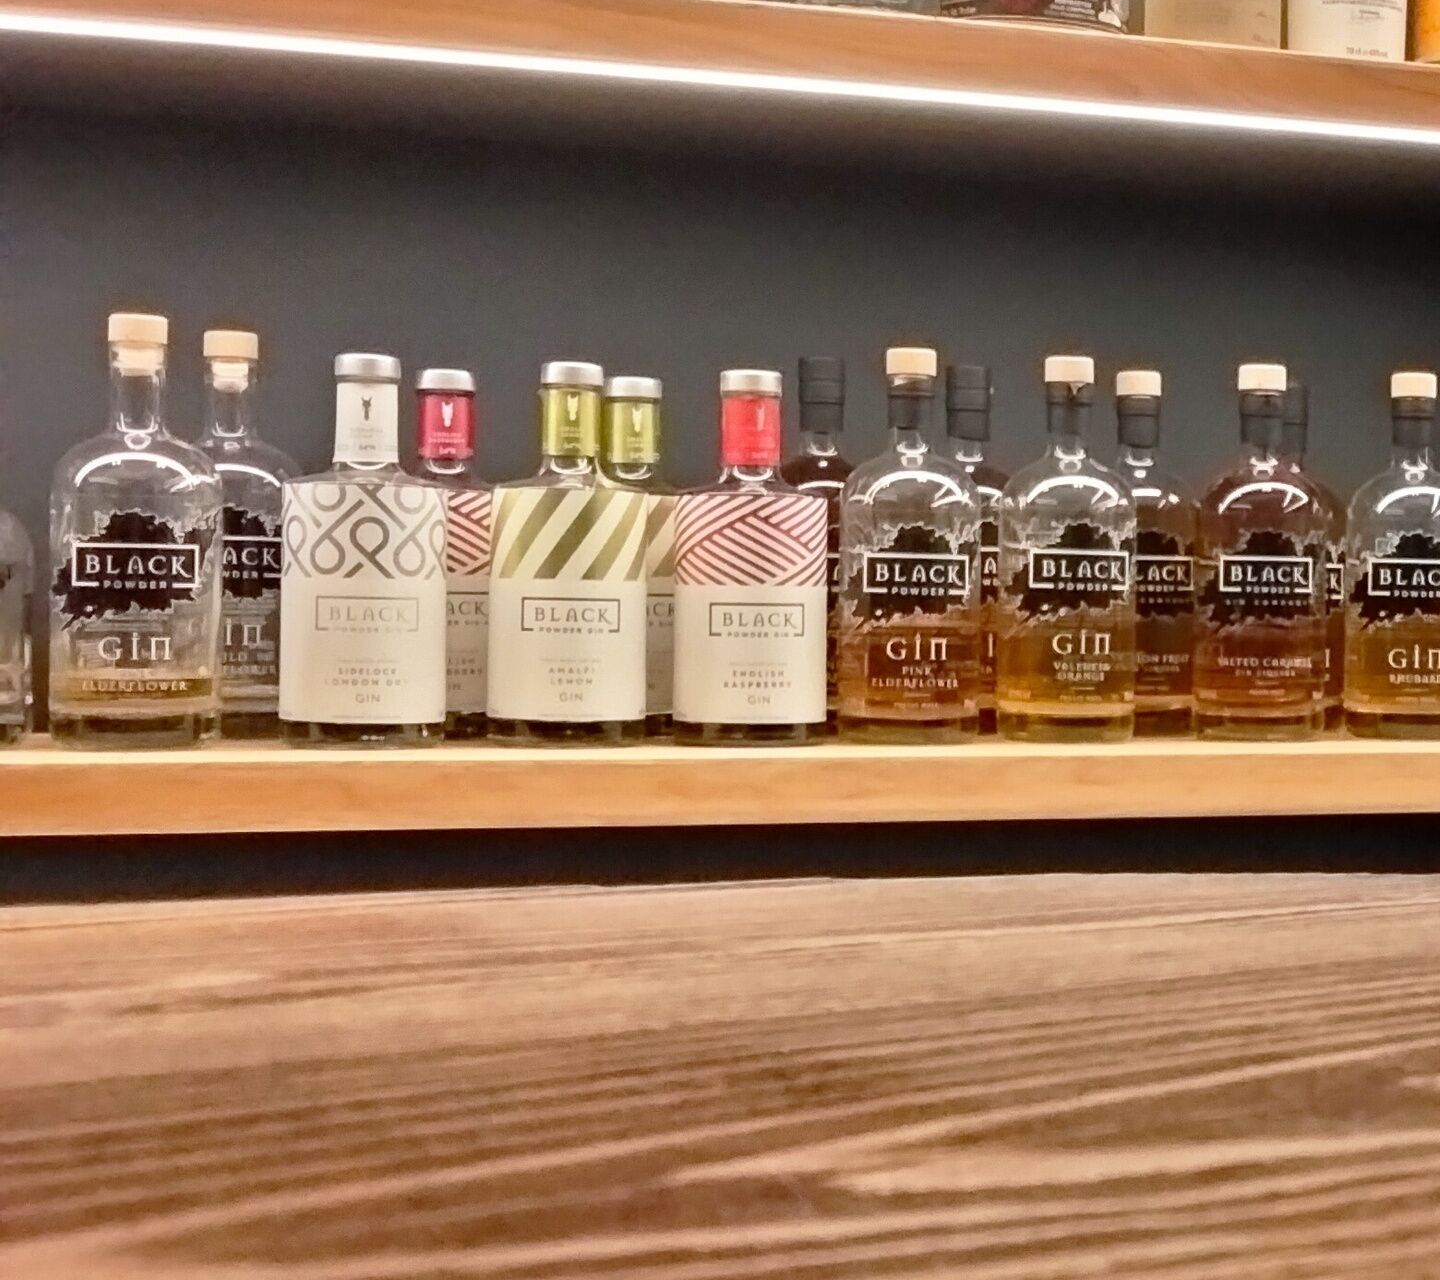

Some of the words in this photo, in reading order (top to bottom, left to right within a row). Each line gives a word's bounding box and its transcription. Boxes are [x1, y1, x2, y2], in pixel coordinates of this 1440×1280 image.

[223, 547, 280, 569] ACK
[85, 554, 192, 578] BLACK
[1042, 559, 1124, 581] BLACK
[875, 563, 963, 586] BLACK
[1231, 565, 1307, 585] BLACK
[103, 580, 168, 590] POWDER
[891, 587, 945, 596] POWDER
[1058, 583, 1108, 591] POWDER
[1246, 586, 1290, 594] POWDER
[330, 606, 411, 623] BLACK
[447, 601, 488, 616] ACK
[535, 606, 613, 625] BLACK
[722, 612, 798, 629] BLACK
[871, 677, 959, 689] ELDERFLOWER
[355, 694, 381, 704] GIN
[559, 693, 584, 703] GIN
[747, 695, 771, 705] GIN
